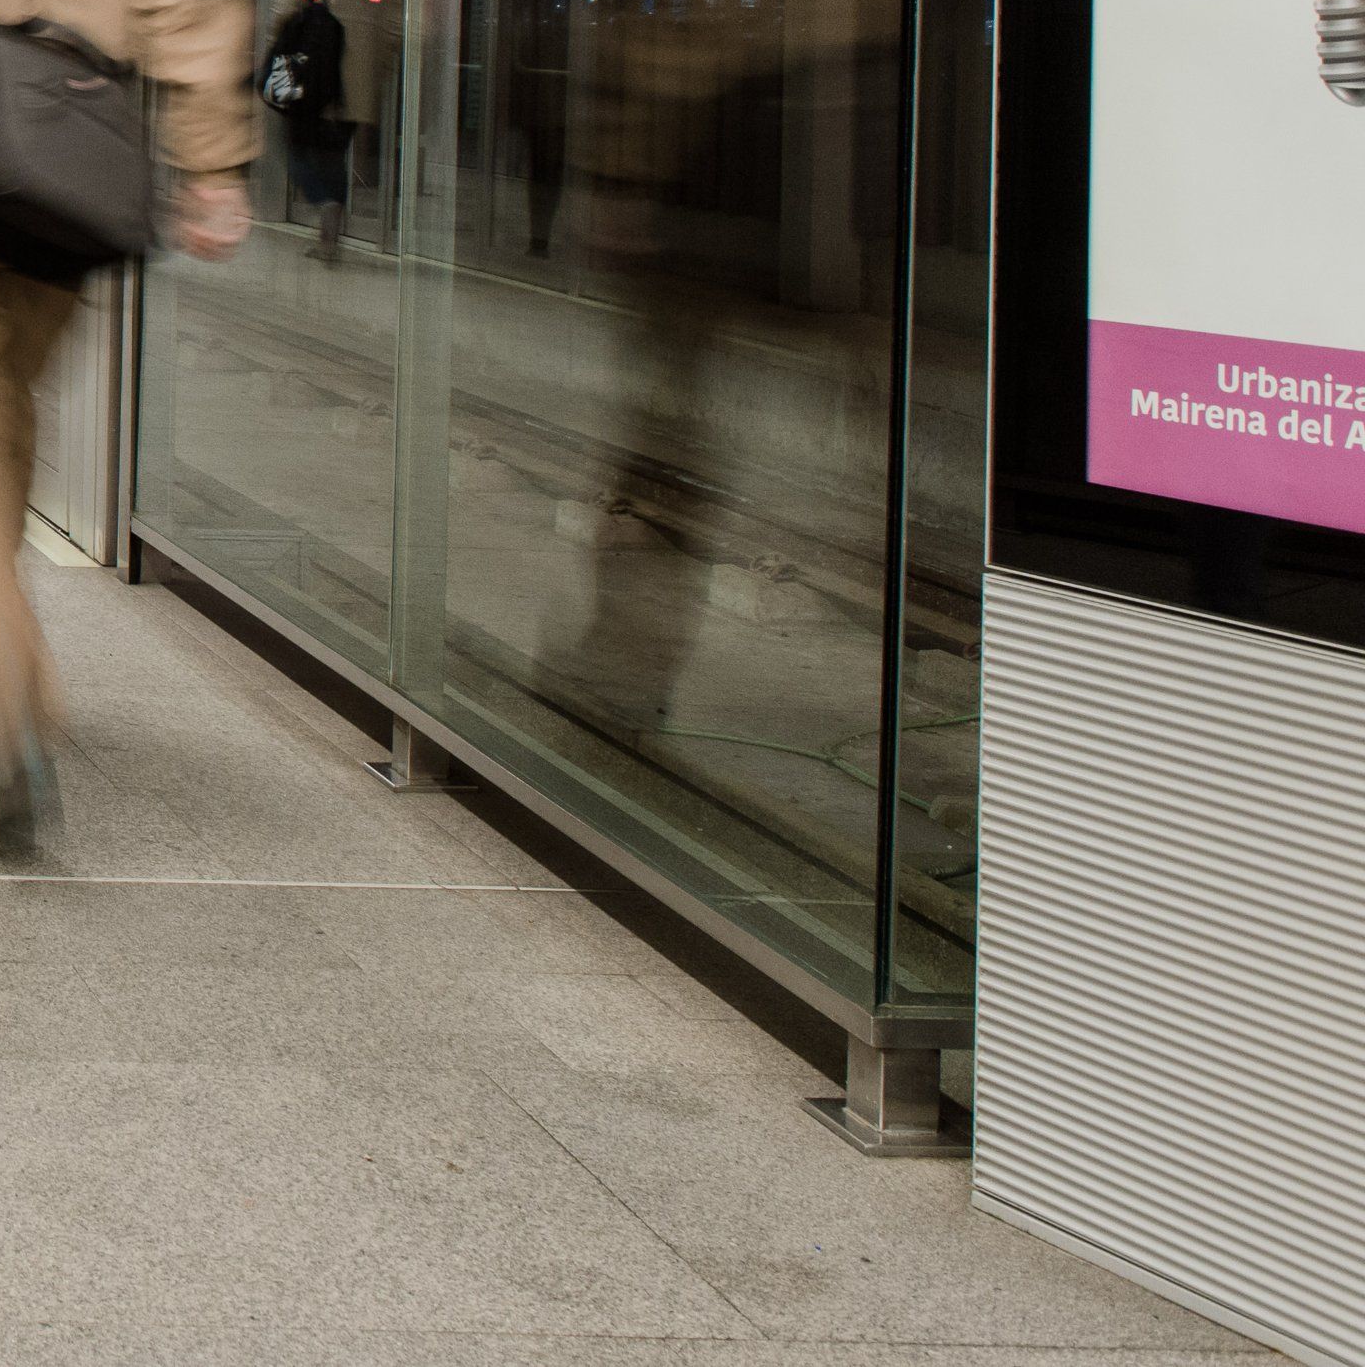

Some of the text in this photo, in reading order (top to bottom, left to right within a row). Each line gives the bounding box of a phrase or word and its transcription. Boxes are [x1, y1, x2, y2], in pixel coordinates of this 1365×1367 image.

[1217, 363, 1365, 412] Urbaniza
[1131, 388, 1268, 437] Mairena
[1277, 409, 1334, 447] del
